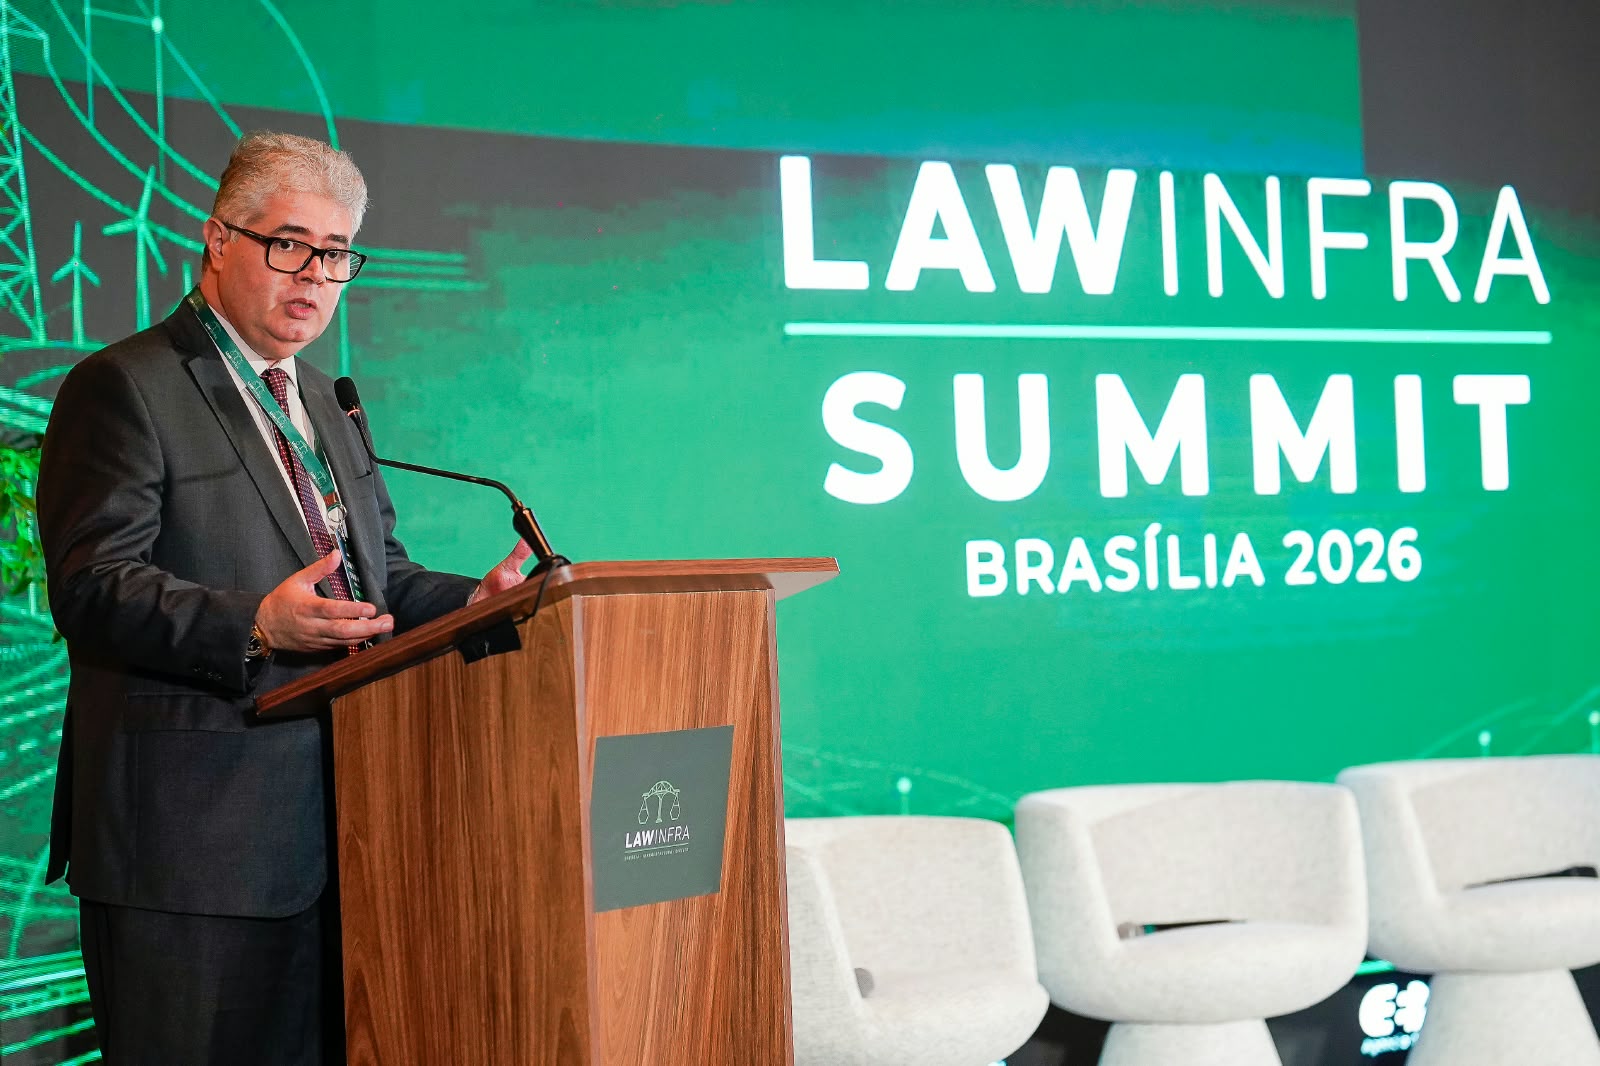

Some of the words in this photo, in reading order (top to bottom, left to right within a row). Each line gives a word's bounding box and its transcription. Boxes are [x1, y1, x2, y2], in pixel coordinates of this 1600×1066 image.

[779, 156, 1551, 304] LAWINFRA
[821, 371, 1531, 504] SUMMIT
[965, 522, 1266, 598] BRASÍLIA
[1282, 527, 1423, 585] 2026
[624, 825, 690, 848] LAWINFRA
